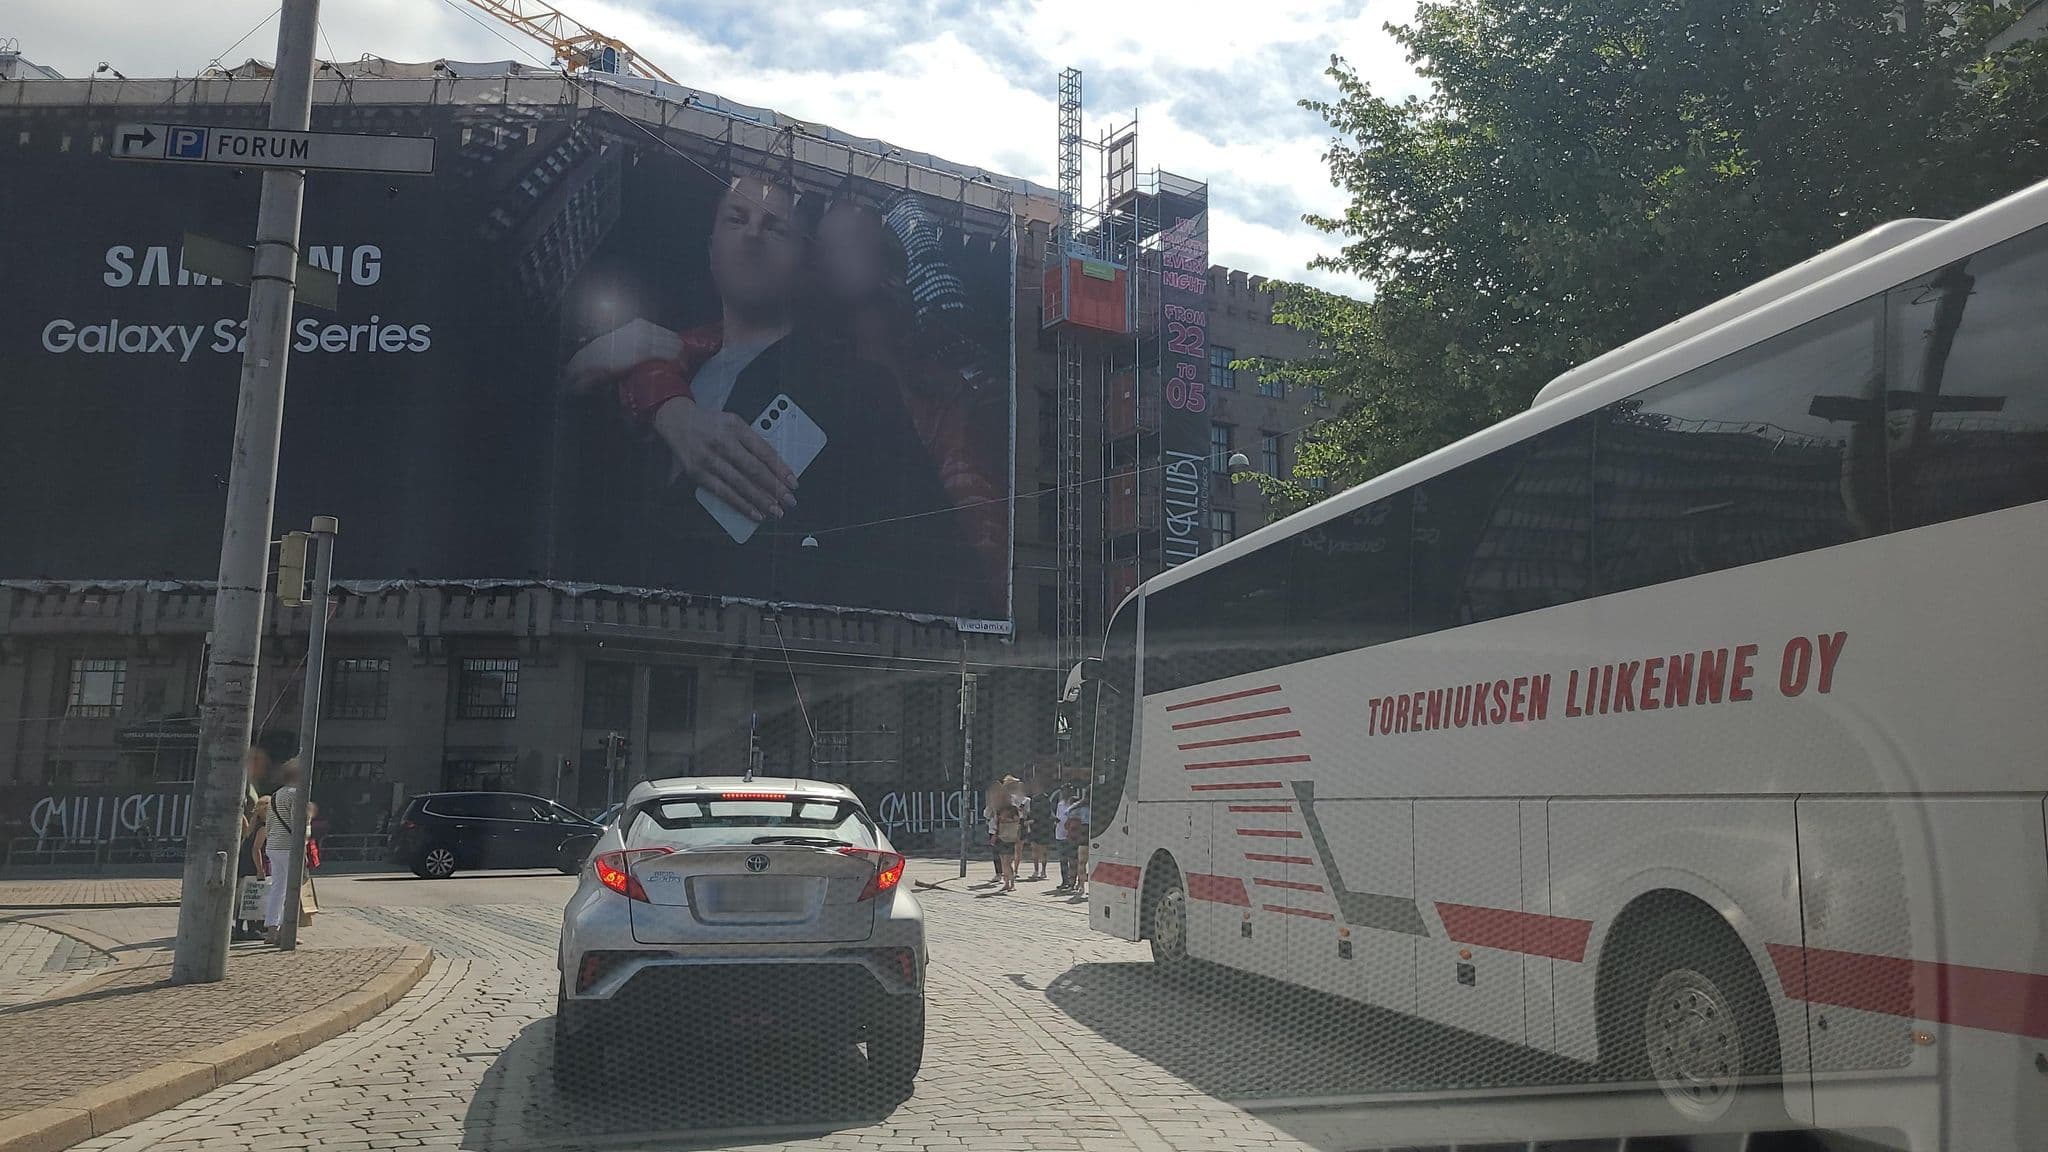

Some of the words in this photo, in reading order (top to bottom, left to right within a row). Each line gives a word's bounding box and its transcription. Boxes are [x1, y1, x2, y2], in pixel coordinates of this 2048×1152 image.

[217, 134, 310, 160] FORUM
[103, 245, 382, 287] SANG
[1163, 271, 1207, 295] NIGHT
[1164, 304, 1206, 328] FROM
[41, 318, 205, 362] Galaxy
[293, 315, 432, 353] Series
[1167, 322, 1205, 358] 22
[1177, 362, 1197, 380] TO
[1166, 377, 1206, 413] 05
[1367, 673, 1552, 737] TORENIUKSEN
[1564, 643, 1760, 718] LIIKENNE
[1778, 630, 1849, 697] OY
